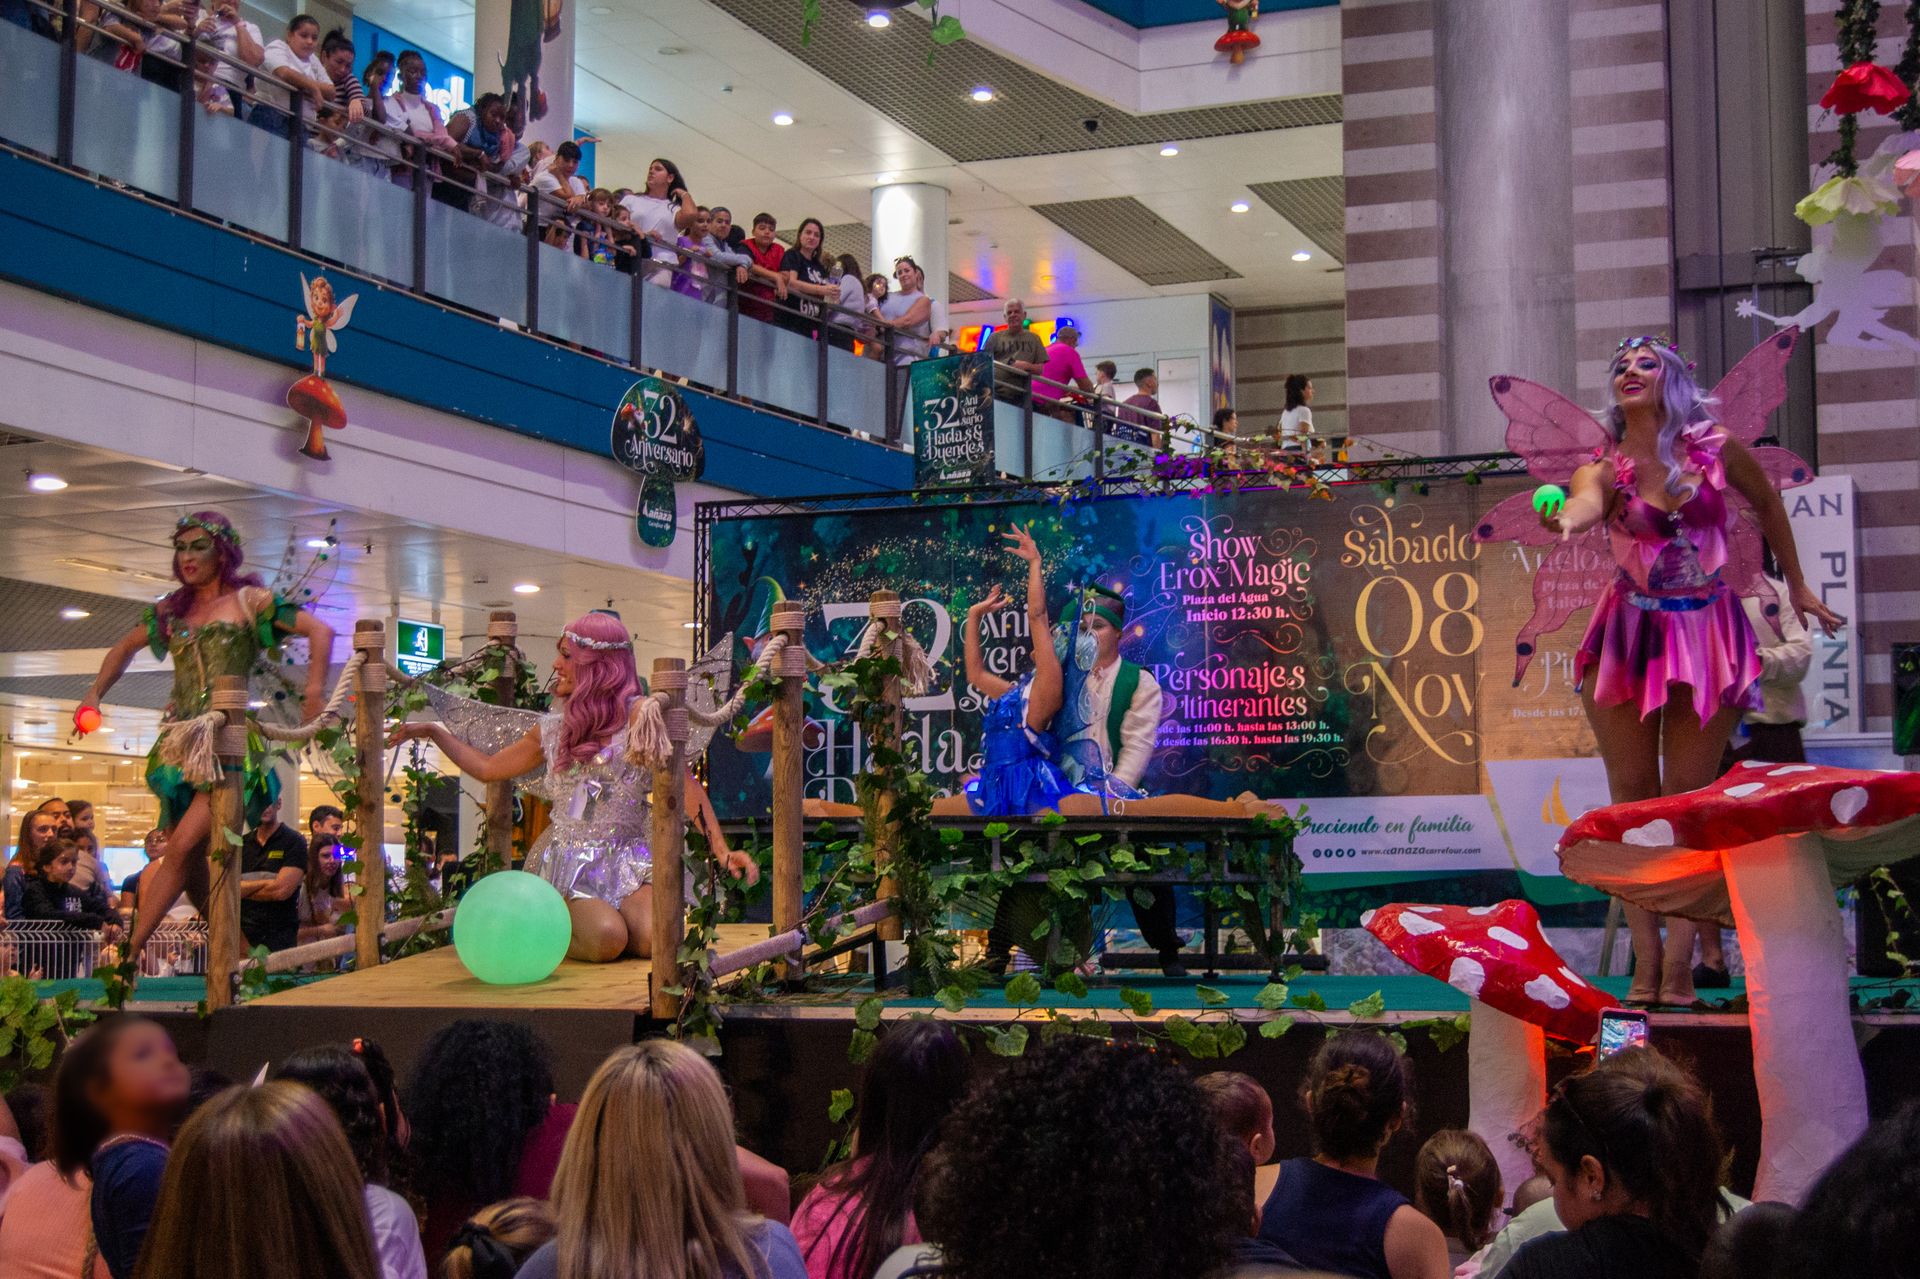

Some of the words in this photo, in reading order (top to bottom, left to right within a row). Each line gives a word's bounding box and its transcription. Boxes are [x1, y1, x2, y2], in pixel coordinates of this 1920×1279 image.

[643, 388, 678, 444] 32
[924, 396, 960, 430] 32
[923, 427, 972, 446] Hadas
[624, 433, 694, 475] Aniversario
[921, 440, 985, 468] Duendes
[1783, 494, 1843, 518] AN
[1187, 515, 1263, 562] Show
[1341, 504, 1482, 567] Sábado
[1160, 561, 1221, 590] Erox
[1229, 557, 1312, 596] Magic
[1182, 595, 1215, 606] Plaza
[1218, 593, 1235, 604] del
[1239, 592, 1269, 605] Agua
[1186, 609, 1227, 622] Inicio
[1231, 607, 1272, 620] 12:30
[1275, 605, 1290, 619] h.
[1355, 572, 1484, 658] 08
[1820, 551, 1849, 729] PLNTA
[980, 645, 1027, 675] er
[1153, 660, 1306, 695] Personajes
[1179, 694, 1308, 719] Itinerantes
[1344, 660, 1486, 766] Nov
[1163, 737, 1190, 747] desde
[1193, 736, 1208, 746] las
[1211, 735, 1239, 745] 16:30
[1241, 735, 1252, 745] h.
[1254, 734, 1282, 744] hasta
[1285, 734, 1299, 744] las
[1302, 733, 1331, 743] 19:30
[1333, 732, 1344, 743] h.
[1177, 723, 1191, 734] las
[1194, 723, 1222, 734] 11:00
[1224, 722, 1235, 733] h.
[1237, 722, 1265, 732] hasta
[1268, 721, 1283, 732] las
[1286, 720, 1316, 731] 13:00
[1319, 720, 1330, 730] h.
[1385, 822, 1404, 834] en
[1408, 814, 1473, 844] familia
